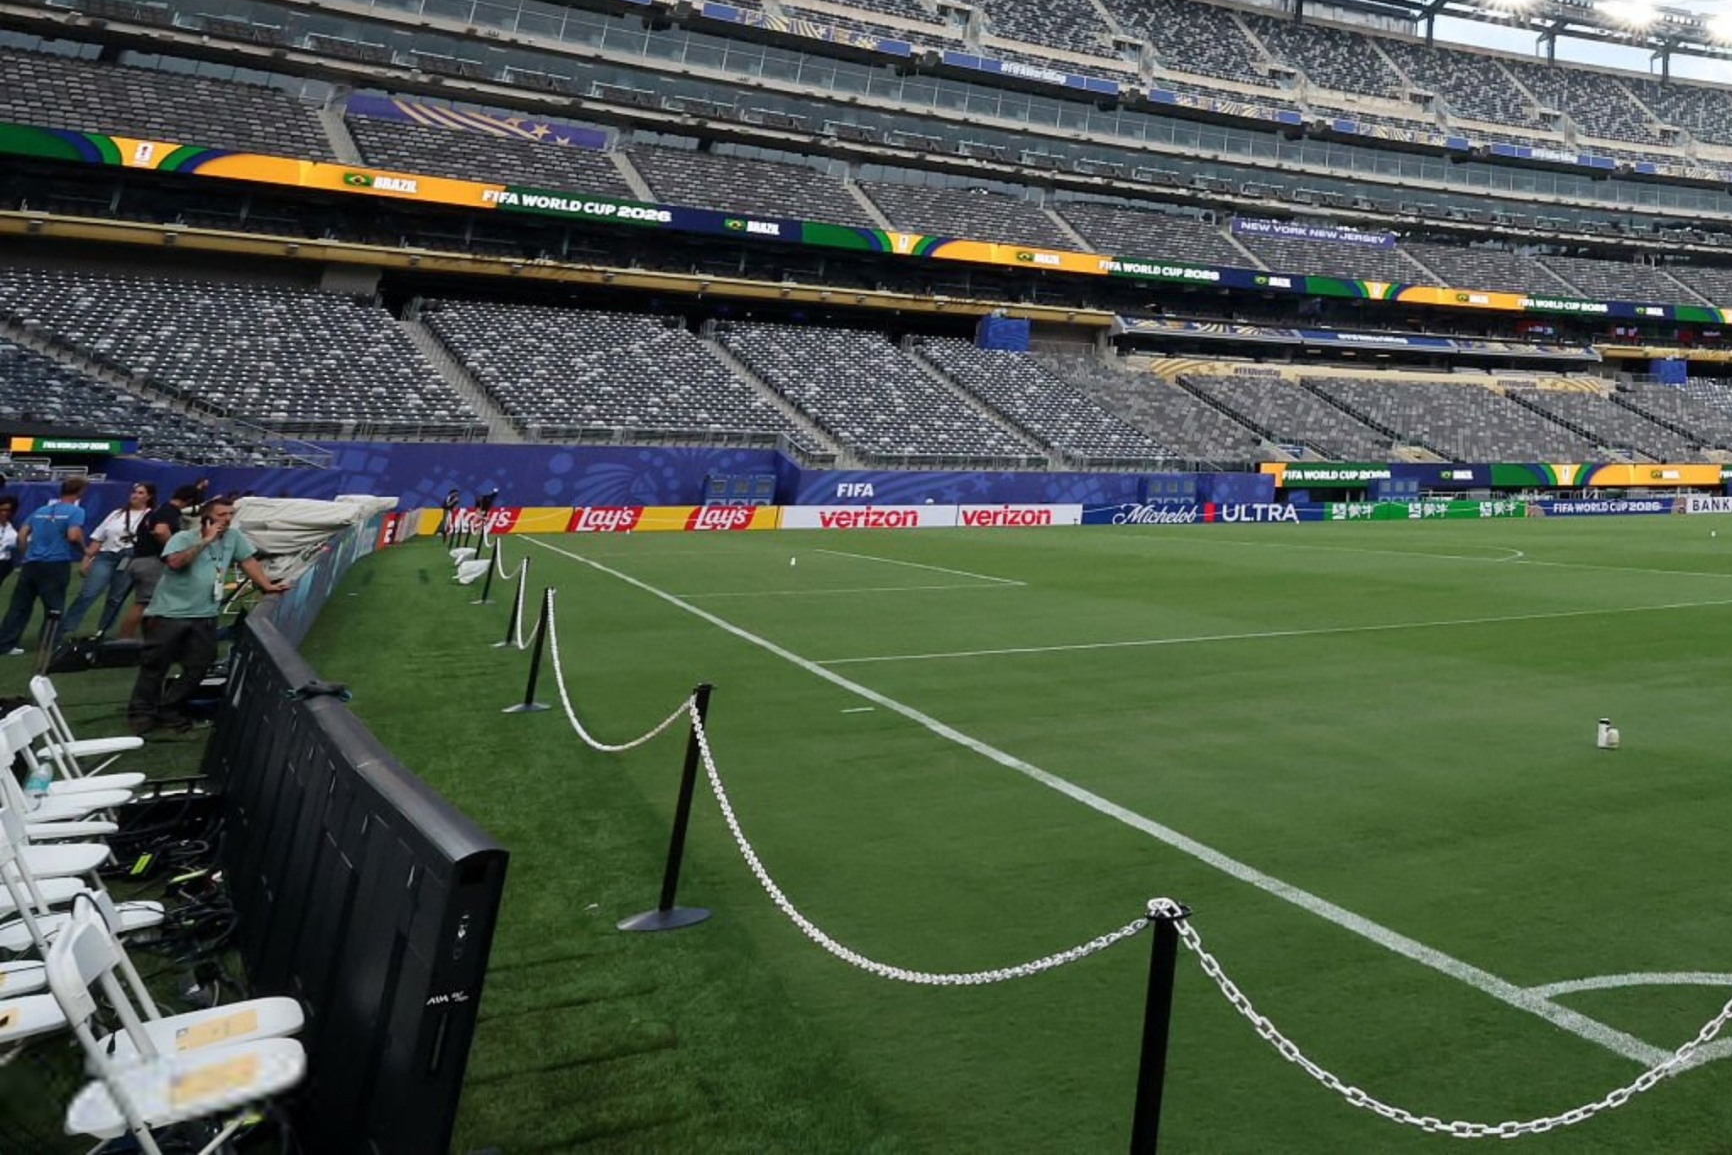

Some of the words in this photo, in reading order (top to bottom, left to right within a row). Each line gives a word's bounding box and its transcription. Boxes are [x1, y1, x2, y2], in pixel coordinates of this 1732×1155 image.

[373, 176, 418, 194] BRAZIL
[482, 189, 520, 204] FIFA
[522, 194, 582, 213] WORLD
[583, 201, 616, 216] CUP
[617, 205, 672, 223] 2026
[746, 220, 780, 235] BRAZIL
[1241, 221, 1270, 232] NEW
[1273, 225, 1307, 236] YORK
[1309, 228, 1337, 239] NEW
[1339, 232, 1387, 244] JERSEY
[1099, 260, 1121, 271] FIFA
[1123, 263, 1161, 275] WORLD
[1162, 266, 1183, 277] CUP
[1282, 470, 1304, 480] FIFA
[1304, 470, 1338, 480] WORLD
[1339, 470, 1359, 480] CUP
[836, 483, 874, 497] FIFA
[1112, 503, 1198, 524] Michelob
[1222, 503, 1298, 522] ULTRA
[1553, 503, 1574, 513] FIFA
[1575, 502, 1609, 512] WORLD
[1610, 502, 1628, 512] CUP
[1628, 501, 1661, 512] 2026
[1693, 498, 1730, 511] BANK
[576, 506, 635, 532] Lay's
[699, 506, 748, 530] Lay's
[819, 505, 918, 528] verizon
[962, 504, 1052, 526] verizon
